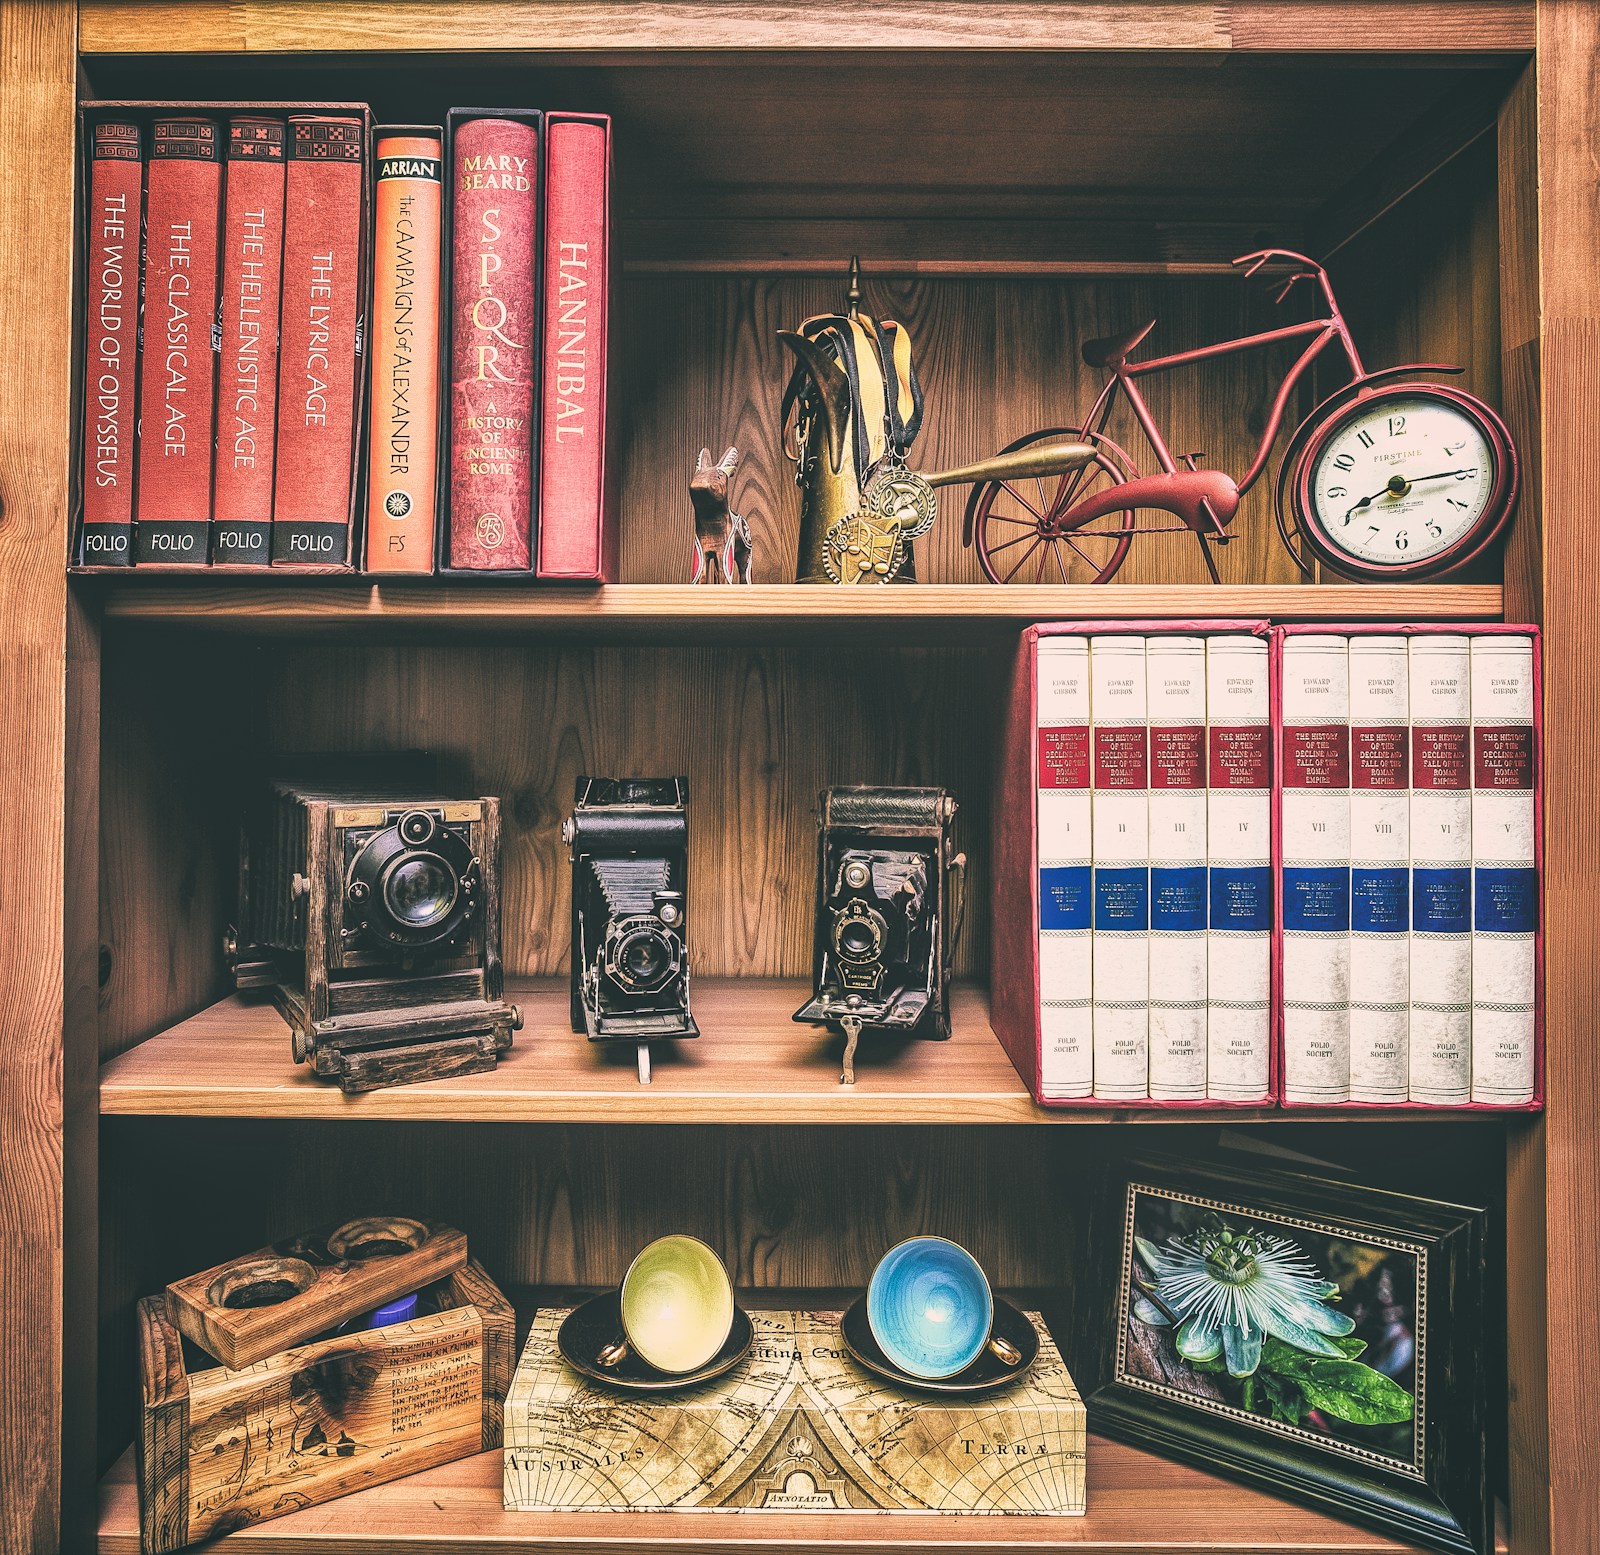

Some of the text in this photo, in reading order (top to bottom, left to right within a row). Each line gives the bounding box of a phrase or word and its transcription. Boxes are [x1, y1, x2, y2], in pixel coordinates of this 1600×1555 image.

[381, 160, 435, 177] ARRIAN
[464, 155, 528, 173] MARY
[462, 174, 531, 192] BEARD
[394, 219, 415, 336] CAMPAIGNS
[96, 193, 126, 487] THE WORLD OF ODYSSEUS
[165, 220, 191, 457] THE CLASSICAL AGE
[234, 209, 265, 469] THE HELLENISTIC AGE
[305, 251, 333, 427] THE LYRIC AGE
[396, 337, 412, 353] of
[555, 240, 588, 444] HANNIBAL
[390, 353, 412, 475] ALEXANDER
[486, 401, 497, 413] A
[1387, 416, 1406, 437] 12
[481, 431, 501, 444] OF
[1356, 430, 1375, 448] 11
[1443, 441, 1466, 457] 2
[470, 462, 514, 475] ROME
[1333, 453, 1355, 472] 10
[1327, 486, 1347, 498] 9
[1446, 498, 1469, 513] 4
[1338, 510, 1358, 527] 8
[1362, 525, 1381, 545] 7
[1425, 518, 1442, 538] 5
[86, 535, 127, 551] FOLIO
[151, 534, 194, 551] FOLIO
[219, 531, 262, 549] FOLIO
[290, 534, 333, 552] FOLIO
[389, 535, 406, 552] FS
[1395, 530, 1408, 550] 6
[1175, 823, 1185, 832] III
[1239, 823, 1248, 831] IV
[1312, 823, 1325, 832] VII
[1375, 825, 1392, 833] VIII
[1441, 825, 1450, 833] VI
[1505, 824, 1510, 832] V
[1054, 1045, 1079, 1053] SOCIETY
[749, 1348, 802, 1361] riting
[504, 1446, 644, 1472] AUSTRALES
[769, 1494, 828, 1503] ANNOTATIO
